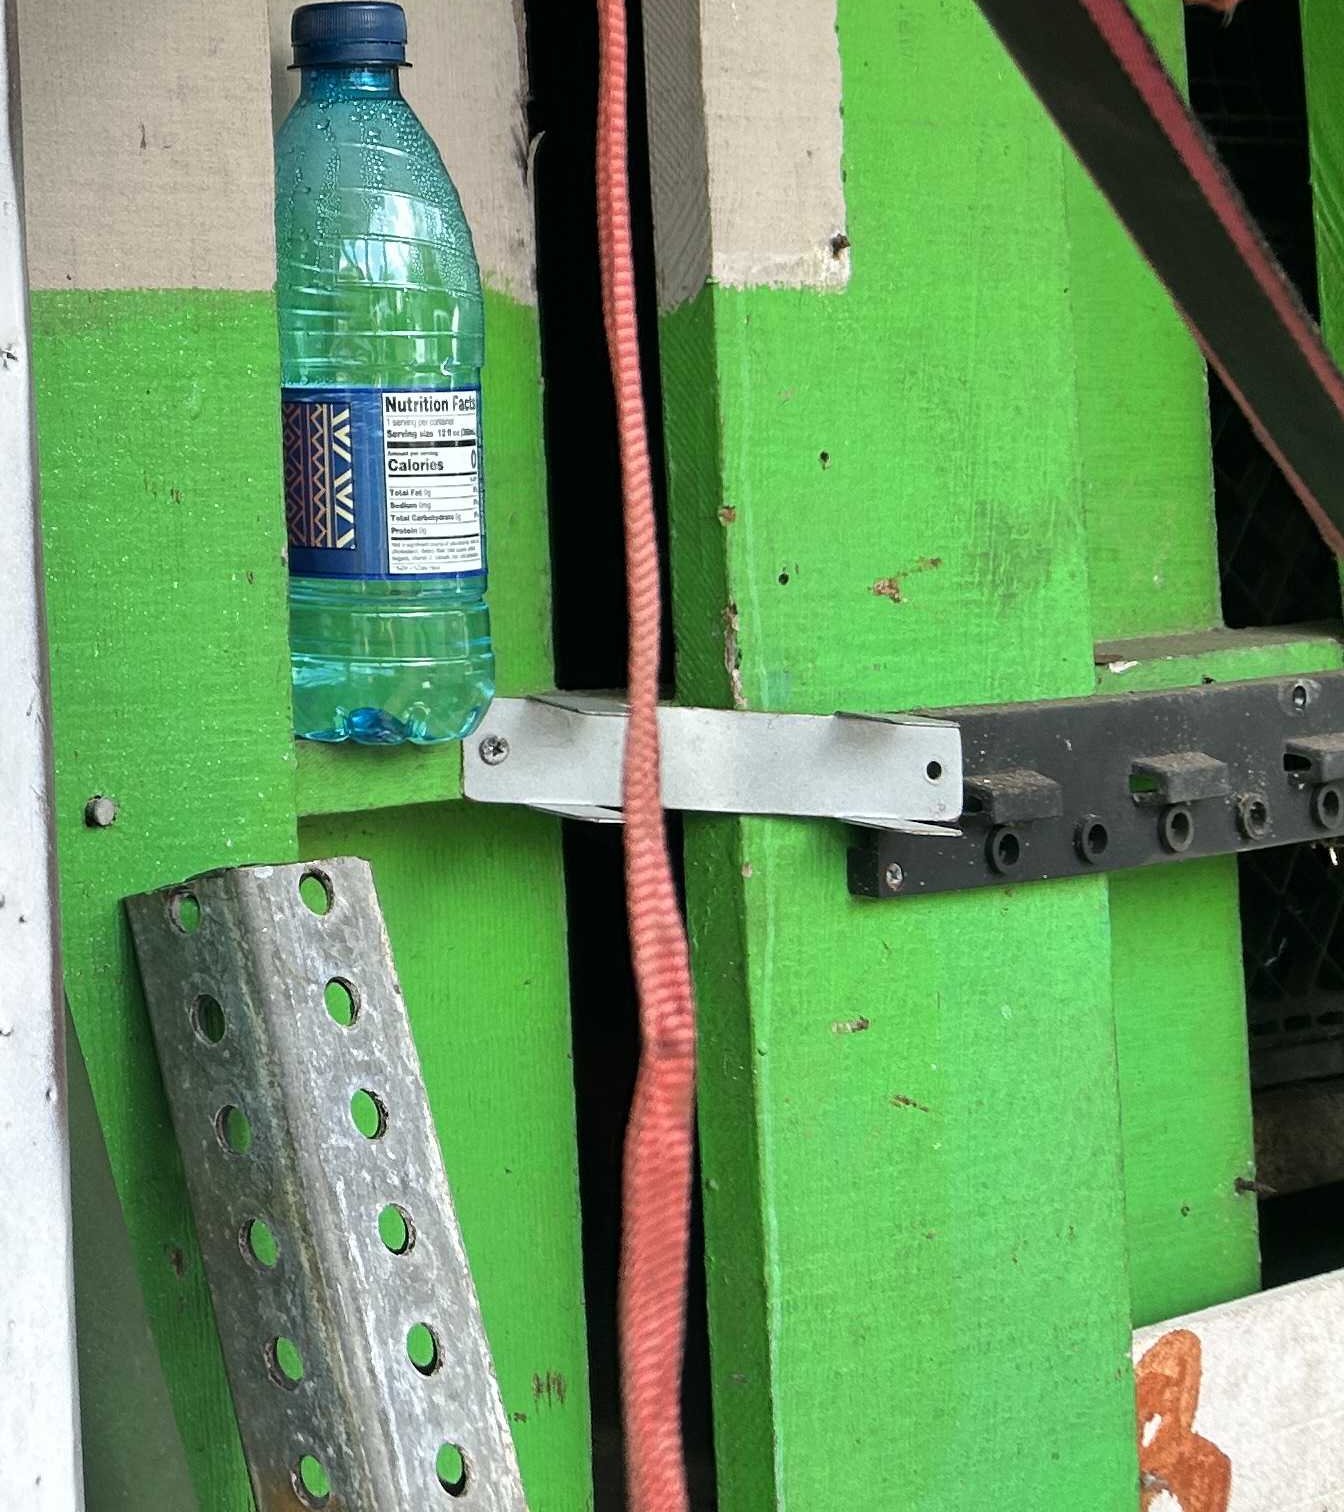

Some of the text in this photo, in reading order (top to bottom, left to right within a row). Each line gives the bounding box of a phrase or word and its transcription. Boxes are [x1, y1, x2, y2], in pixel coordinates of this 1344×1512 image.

[385, 395, 476, 413] Nutrition Facts
[388, 449, 477, 472] Calories 0
